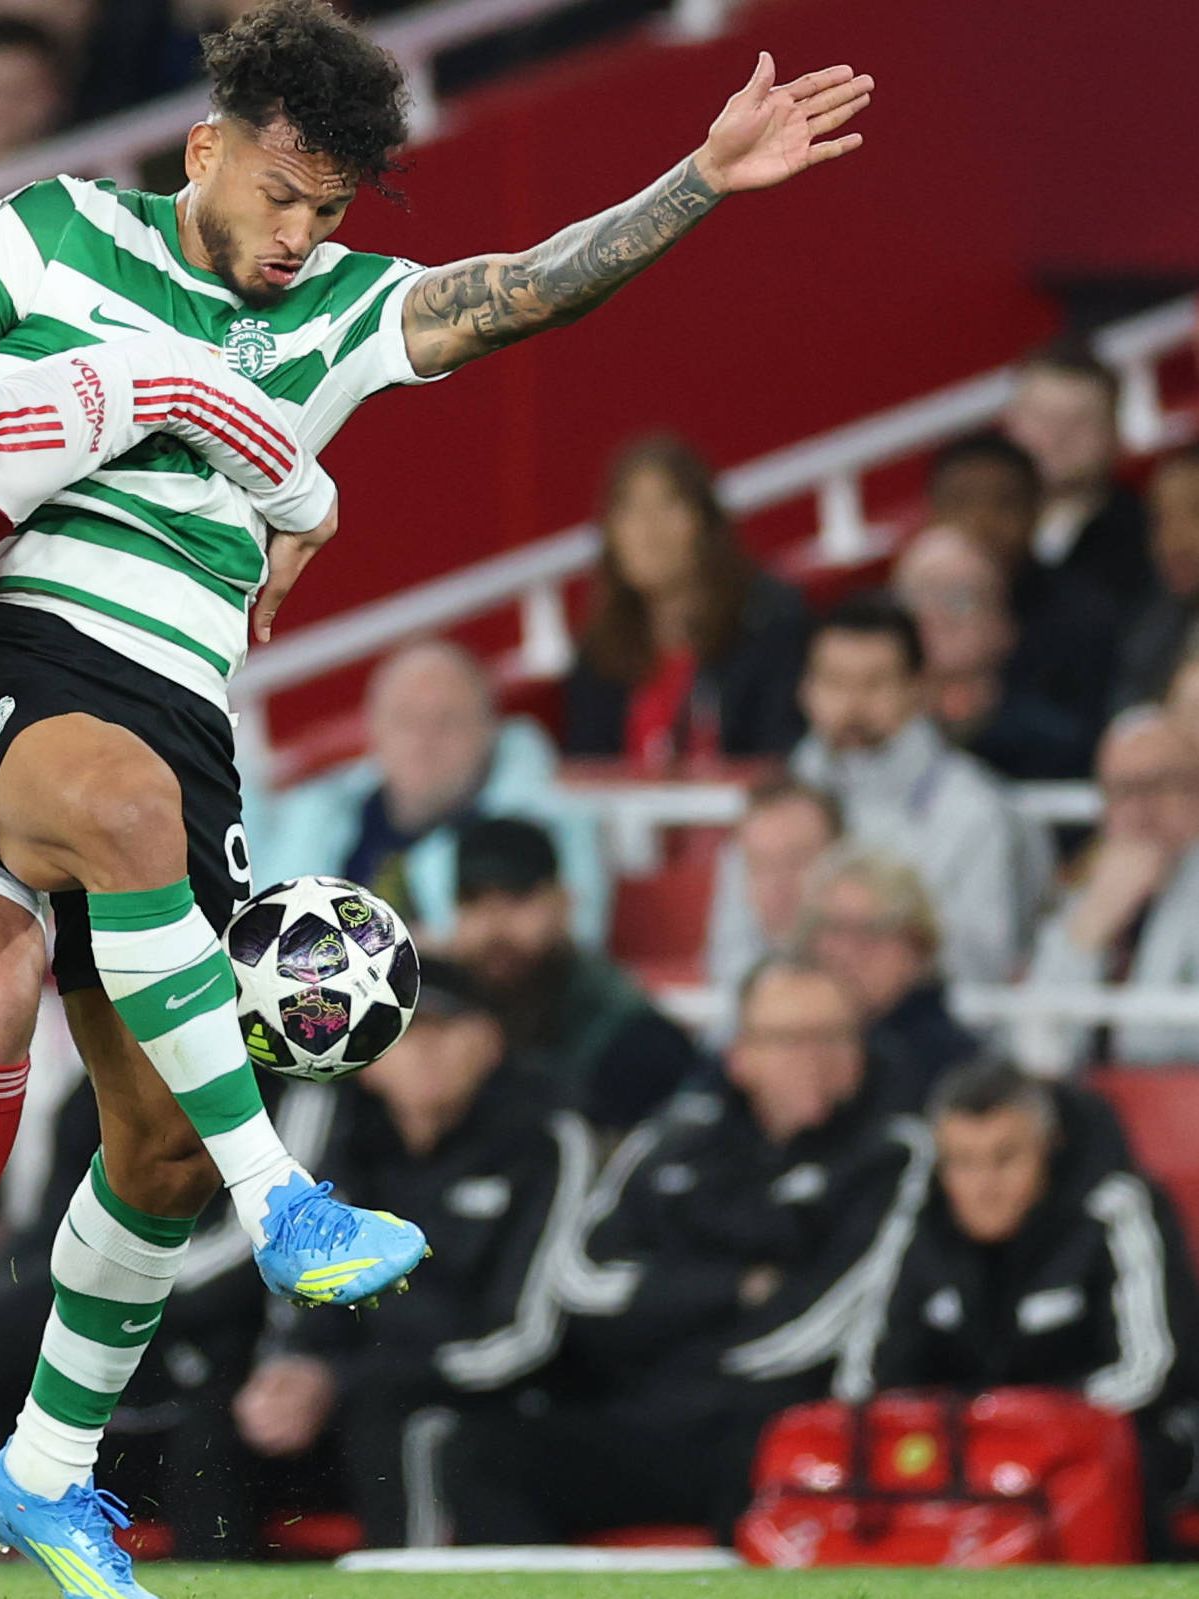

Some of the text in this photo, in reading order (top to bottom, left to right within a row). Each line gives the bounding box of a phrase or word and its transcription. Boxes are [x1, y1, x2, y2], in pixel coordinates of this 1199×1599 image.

[230, 318, 270, 333] SCP
[228, 331, 273, 350] SPORTING
[70, 358, 106, 453] RWANDA
